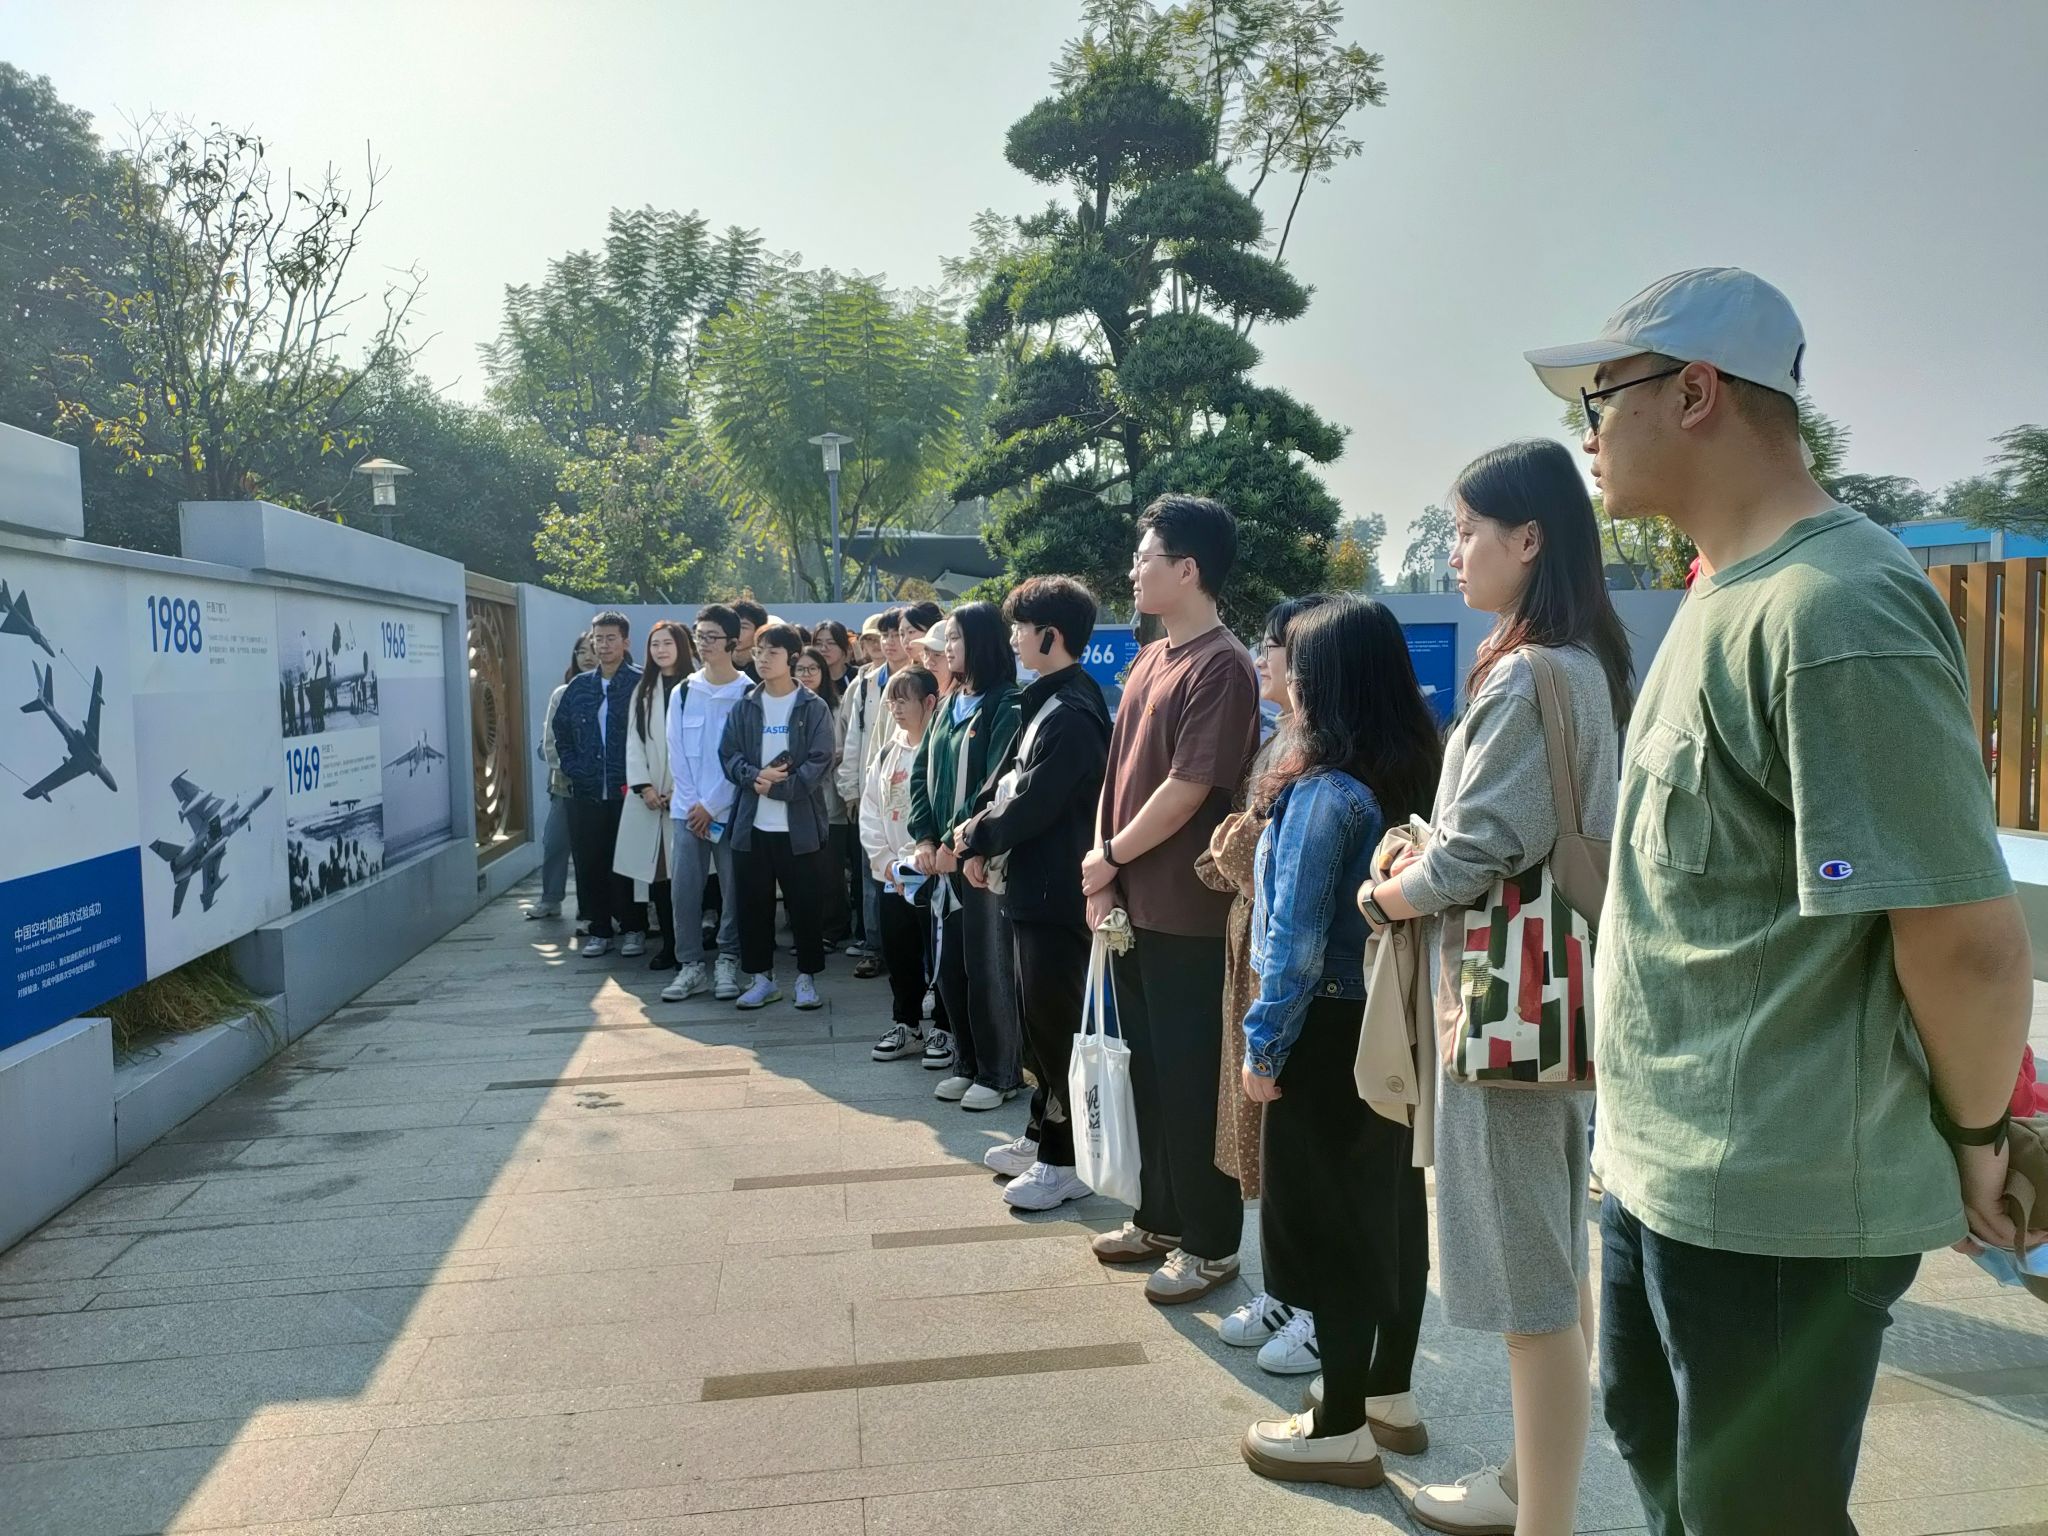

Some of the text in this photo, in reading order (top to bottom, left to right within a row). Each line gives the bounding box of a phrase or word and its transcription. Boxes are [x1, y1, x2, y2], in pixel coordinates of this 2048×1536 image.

[147, 595, 203, 654] 1988
[381, 621, 406, 659] 1968
[286, 745, 320, 795] 1969
[14, 902, 102, 943] 中国空中加油首次试验成功
